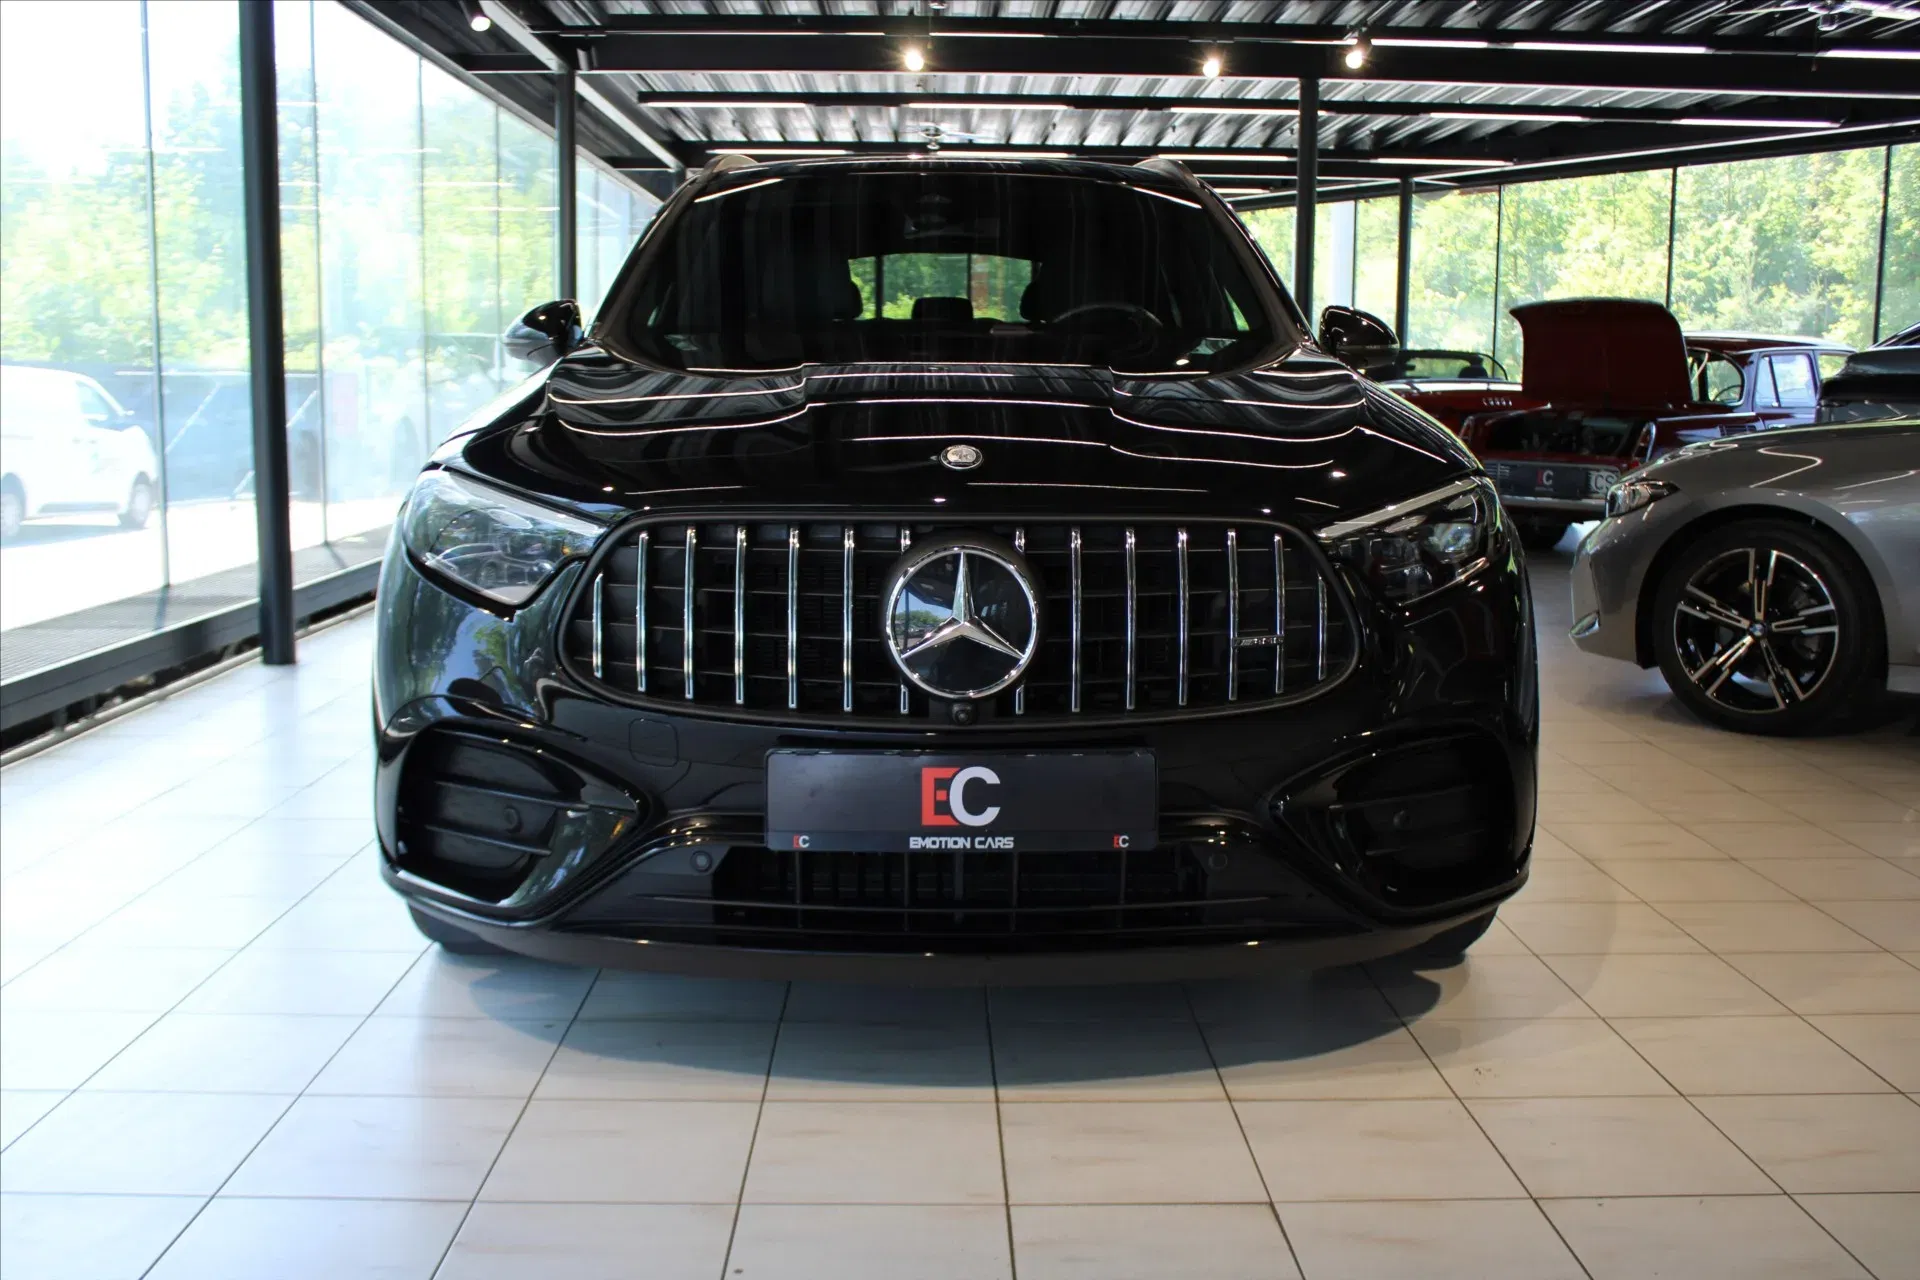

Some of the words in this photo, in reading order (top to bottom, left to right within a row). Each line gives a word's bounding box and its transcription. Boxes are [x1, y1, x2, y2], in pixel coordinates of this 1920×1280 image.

[921, 766, 1001, 827] EC
[909, 836, 971, 849] EMOTION
[974, 836, 1014, 849] CARS
